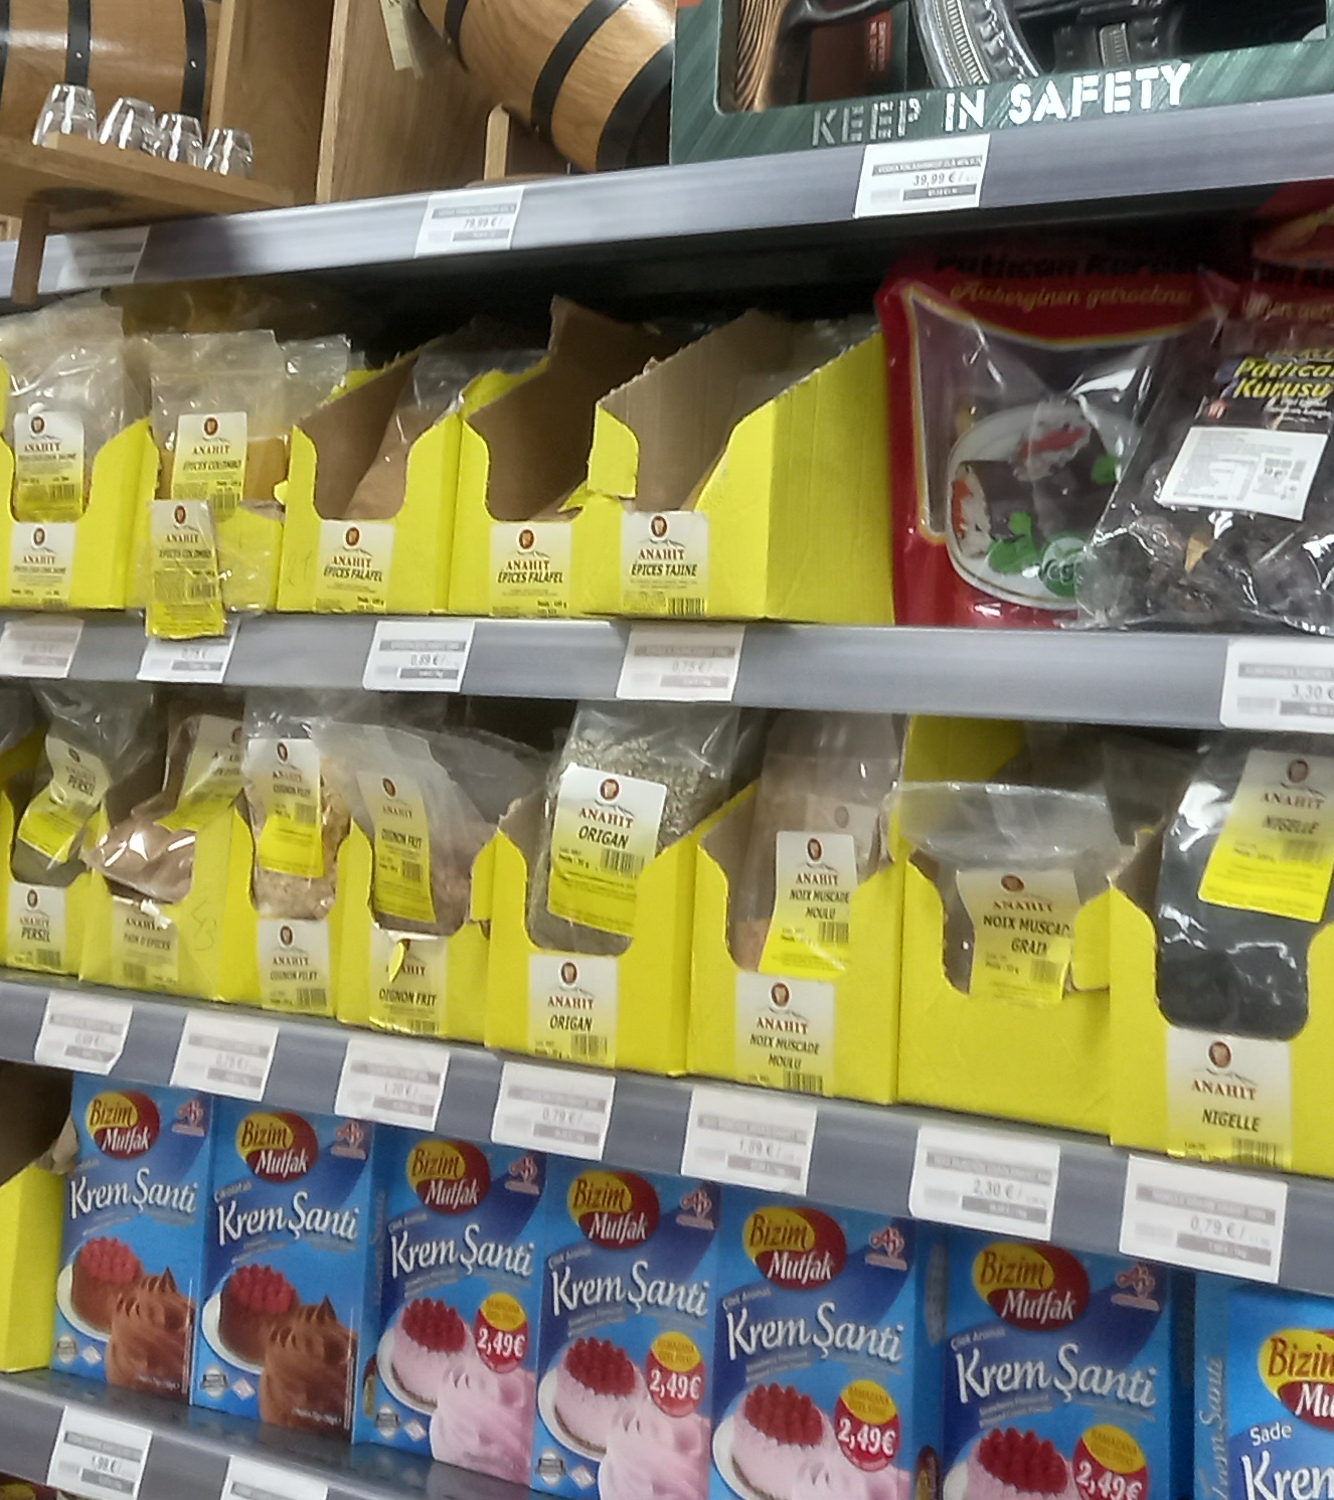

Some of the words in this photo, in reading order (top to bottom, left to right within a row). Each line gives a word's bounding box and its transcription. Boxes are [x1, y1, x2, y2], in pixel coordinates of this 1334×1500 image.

[812, 97, 922, 148] KEEP
[944, 88, 985, 133] IN
[1008, 62, 1192, 127] SAFETY
[332, 555, 373, 568] ANAHIT
[506, 560, 551, 572] ANAHIT
[638, 548, 685, 561] ANAHIT
[528, 570, 564, 584] FALAFEL
[665, 563, 698, 577] TAJINE
[1262, 792, 1326, 810] ANAHIT
[579, 808, 634, 829] ANAHIT
[578, 824, 629, 850] ORIGAN
[796, 873, 839, 886] ANAHIT
[983, 915, 1015, 930] NOIX
[547, 995, 594, 1011] ANAHIT
[549, 1014, 593, 1032] ORIGAN
[756, 1016, 809, 1035] ANAHIT
[749, 1033, 775, 1049] NOIX
[774, 1037, 820, 1056] MUSCADE
[768, 1053, 802, 1070] MOULU
[1191, 1078, 1257, 1101] ANAHIT
[89, 1097, 134, 1127] Bizim
[1201, 1107, 1261, 1133] NIGELLE
[101, 1125, 151, 1155] Mutfak
[240, 1119, 289, 1149] Bizim
[254, 1148, 309, 1179] Mutfak
[411, 1148, 460, 1179] Bizim
[71, 1175, 131, 1220] Krem
[132, 1167, 199, 1214] Şanti
[424, 1179, 481, 1211] Mutfak
[573, 1178, 628, 1213] Bizim
[217, 1200, 288, 1247] Krem
[288, 1190, 361, 1241] Şanti
[588, 1211, 649, 1245] Mutfak
[748, 1213, 810, 1251] Bizim
[1190, 1215, 1222, 1234] 0,79
[391, 1230, 460, 1280] Krem
[459, 1223, 536, 1278] Şanti
[766, 1249, 835, 1286] Mutfak
[979, 1250, 1047, 1289] Bizim
[551, 1266, 627, 1317] Krem
[627, 1260, 712, 1318] Şanti
[1000, 1288, 1076, 1325] Mutfak
[477, 1327, 527, 1360] 2,49€
[726, 1306, 811, 1361] Krem
[812, 1301, 906, 1364] Şanti
[649, 1368, 704, 1401] 2,49€
[955, 1347, 1052, 1404] Krem
[1052, 1342, 1159, 1409] Şanti
[837, 1417, 898, 1456] 2,49€
[1249, 1420, 1294, 1447] Sade
